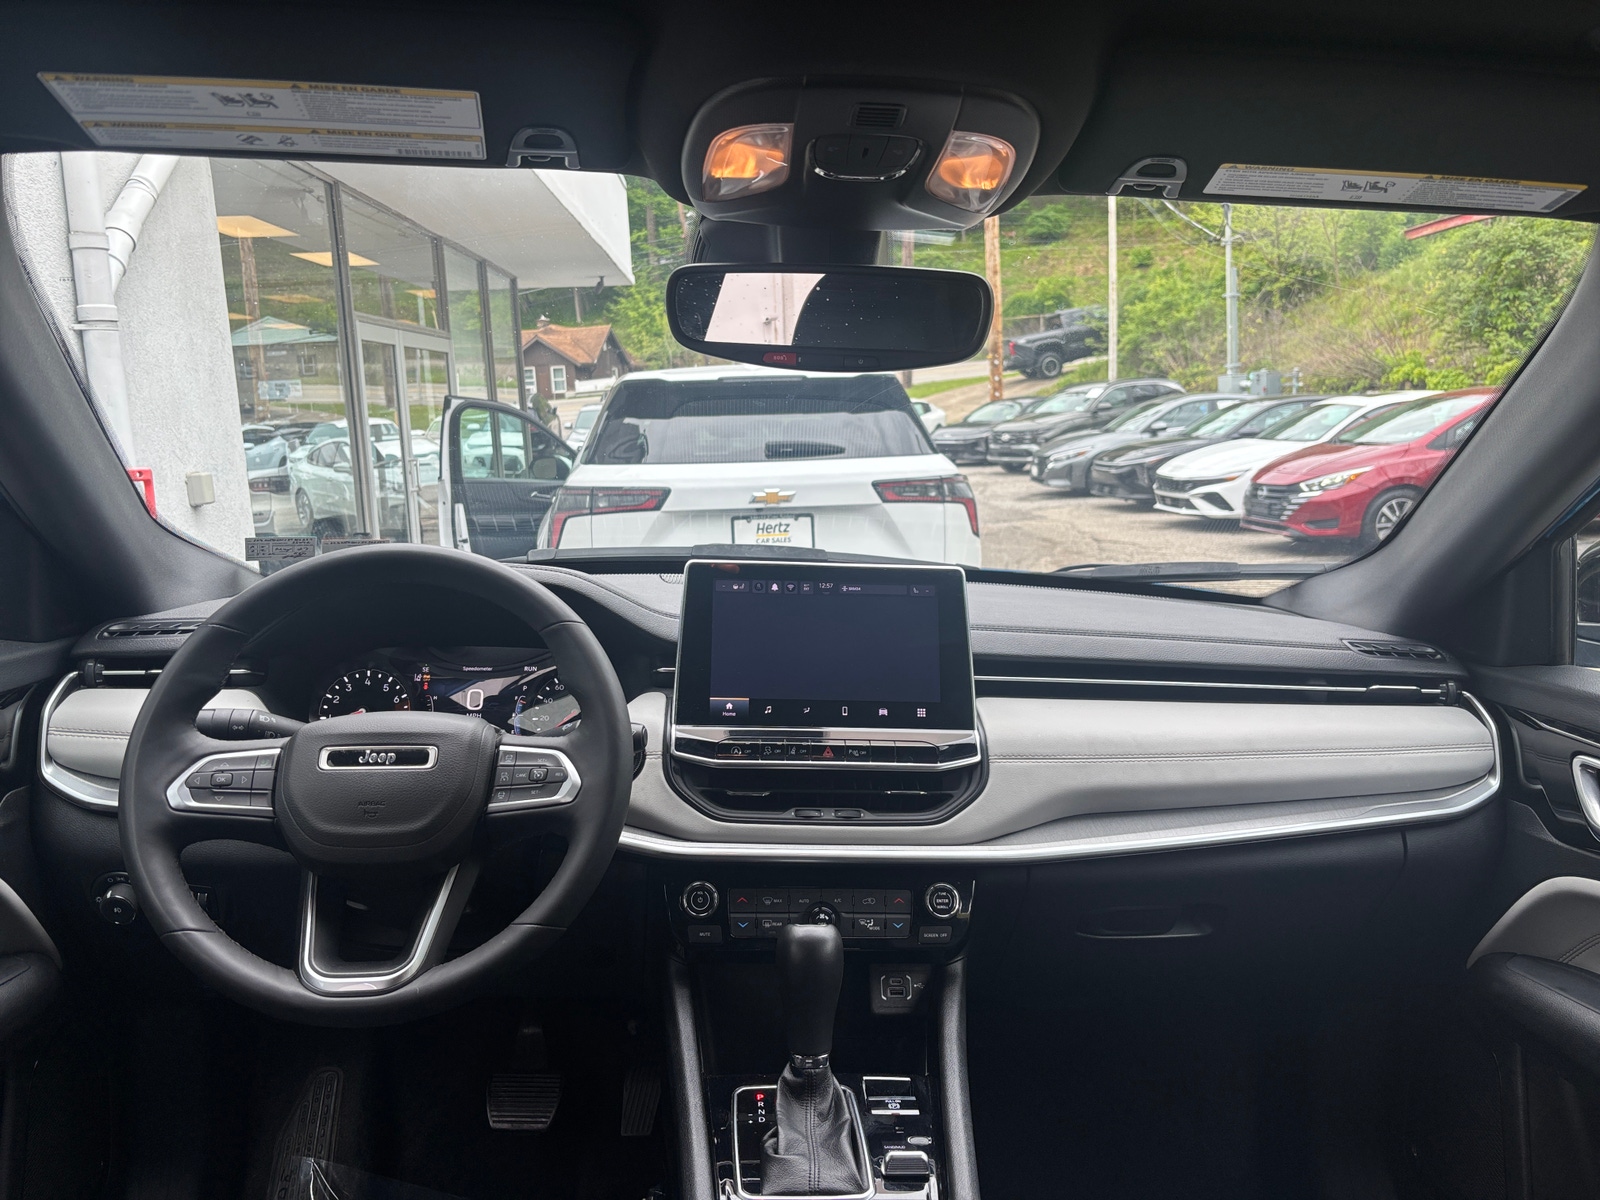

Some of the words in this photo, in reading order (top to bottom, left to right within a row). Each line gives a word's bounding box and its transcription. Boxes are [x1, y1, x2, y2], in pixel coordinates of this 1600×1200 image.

[308, 83, 339, 91] MISE
[361, 86, 400, 94] GARDE
[110, 121, 167, 129] WARNING
[326, 128, 356, 136] MISE
[375, 131, 412, 139] GARDE
[756, 521, 791, 534] Hertz
[771, 536, 792, 544] SALES
[364, 678, 371, 686] 4
[345, 684, 353, 692] 3
[382, 684, 390, 692] 5
[332, 695, 340, 704] 2
[393, 695, 400, 704] 6
[466, 688, 484, 711] 0
[358, 749, 397, 765] Jeep
[358, 800, 386, 808] AIRBAG
